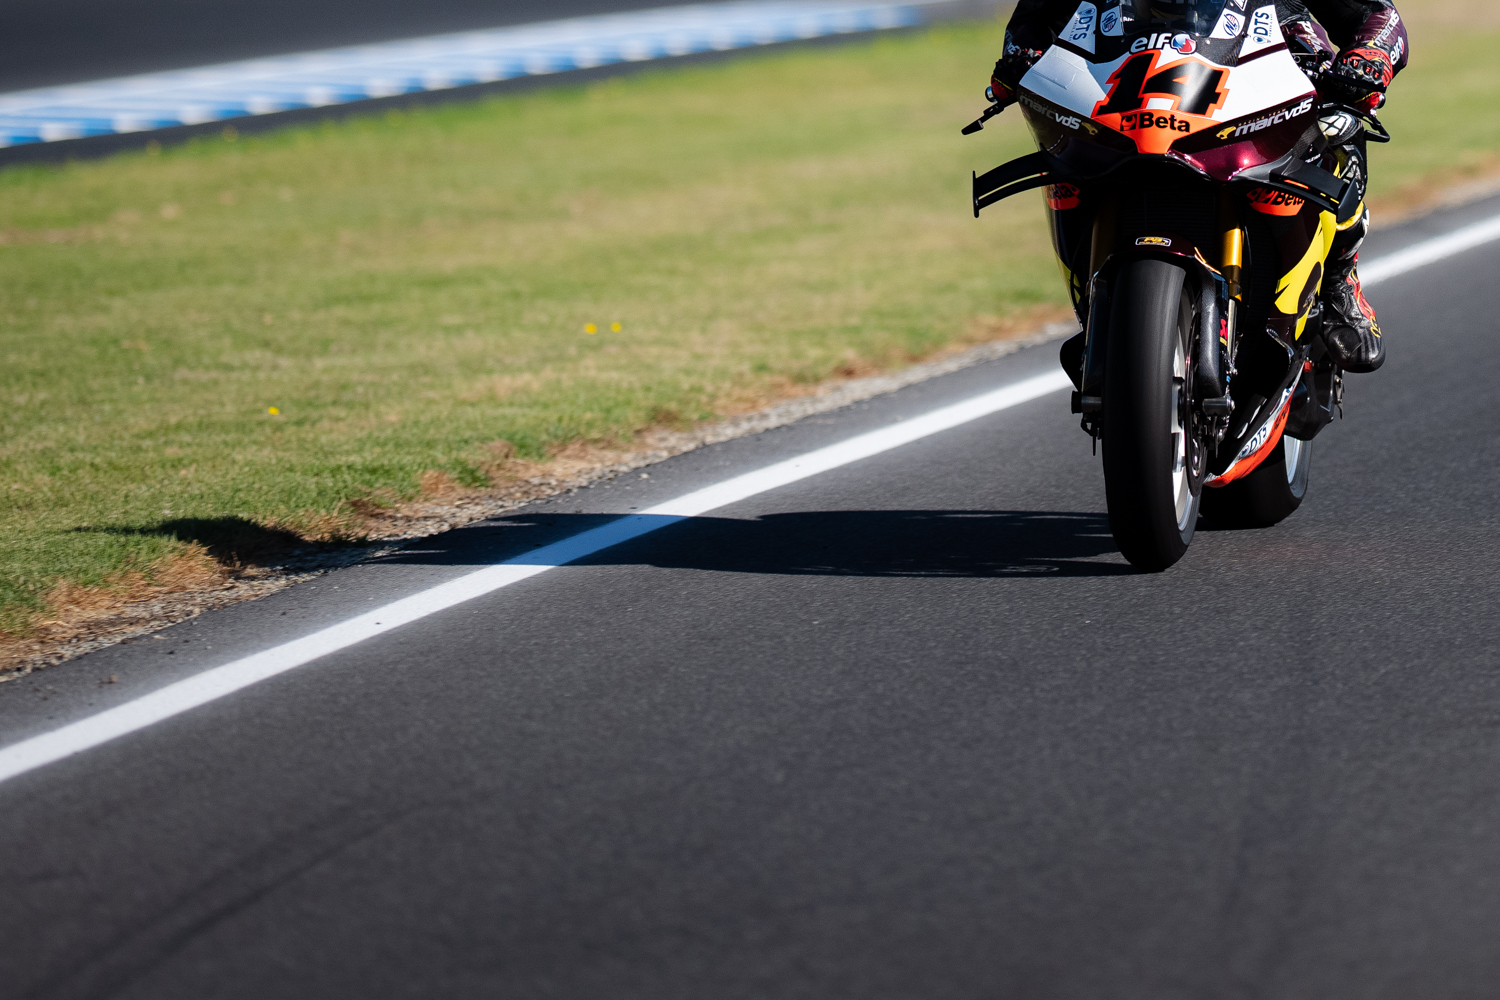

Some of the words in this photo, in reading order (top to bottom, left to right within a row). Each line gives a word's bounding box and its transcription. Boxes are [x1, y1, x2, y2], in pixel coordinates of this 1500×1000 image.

[1073, 14, 1094, 41] DTS
[1254, 12, 1270, 36] DTS
[1095, 51, 1226, 117] 14
[1139, 112, 1191, 133] Beta
